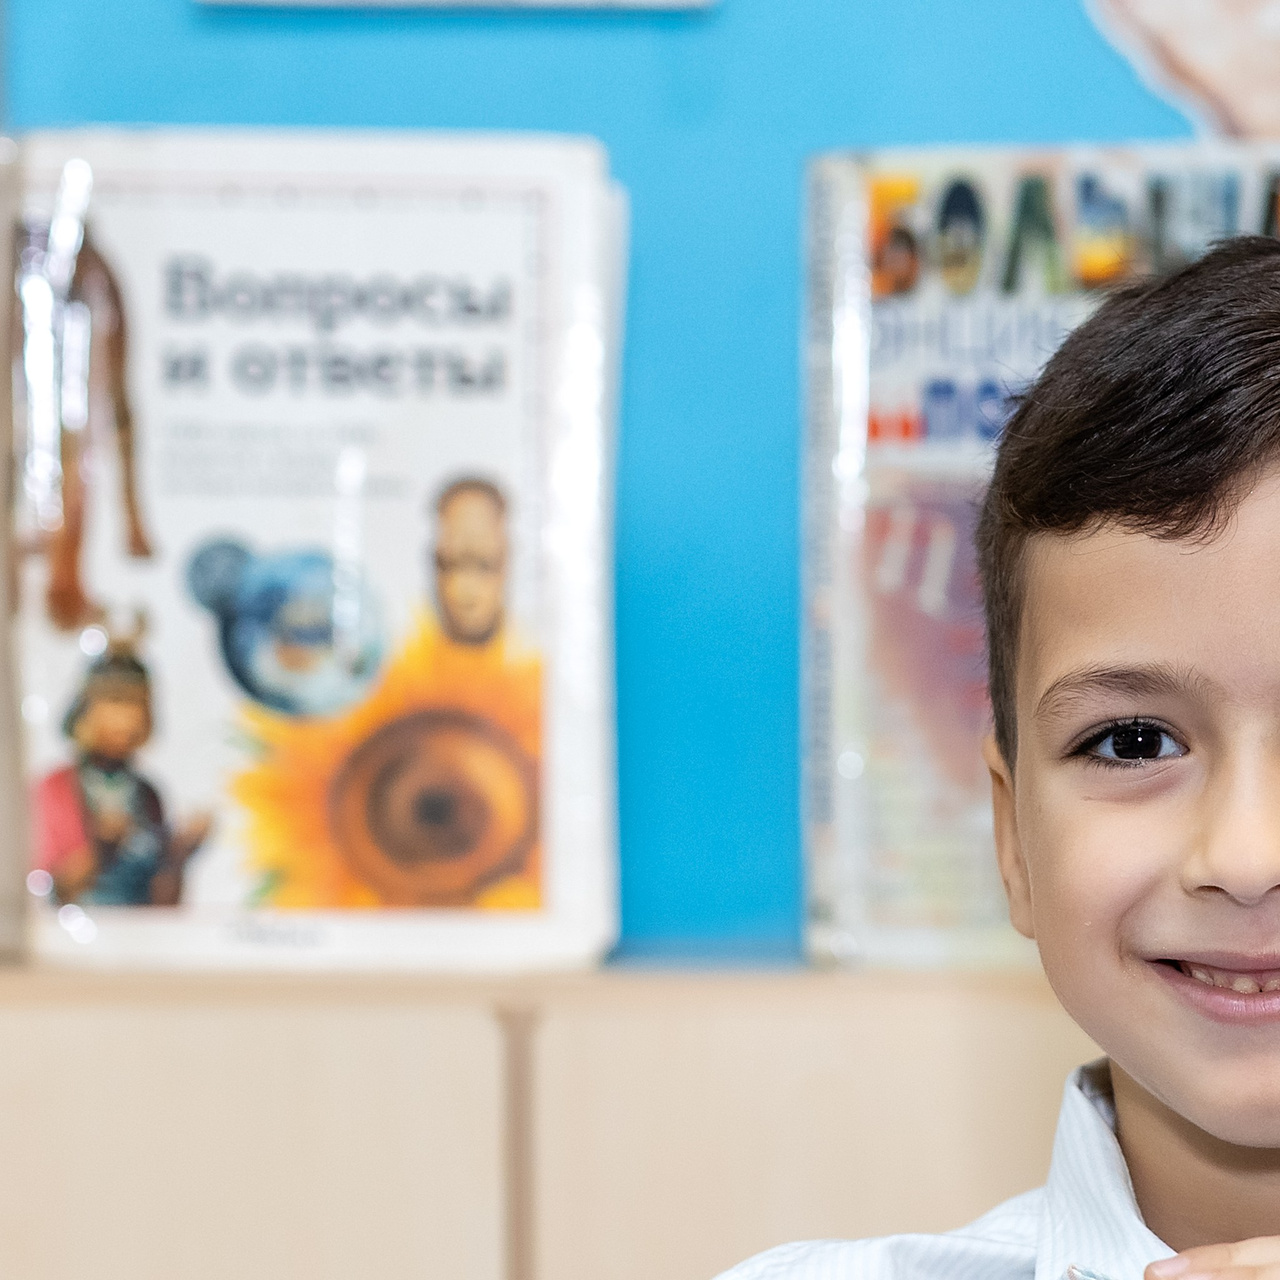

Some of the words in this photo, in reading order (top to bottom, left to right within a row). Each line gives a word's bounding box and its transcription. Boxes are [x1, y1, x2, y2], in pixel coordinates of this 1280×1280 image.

[163, 256, 512, 332] Вопросы
[162, 345, 209, 390] и
[229, 344, 506, 392] ответы
